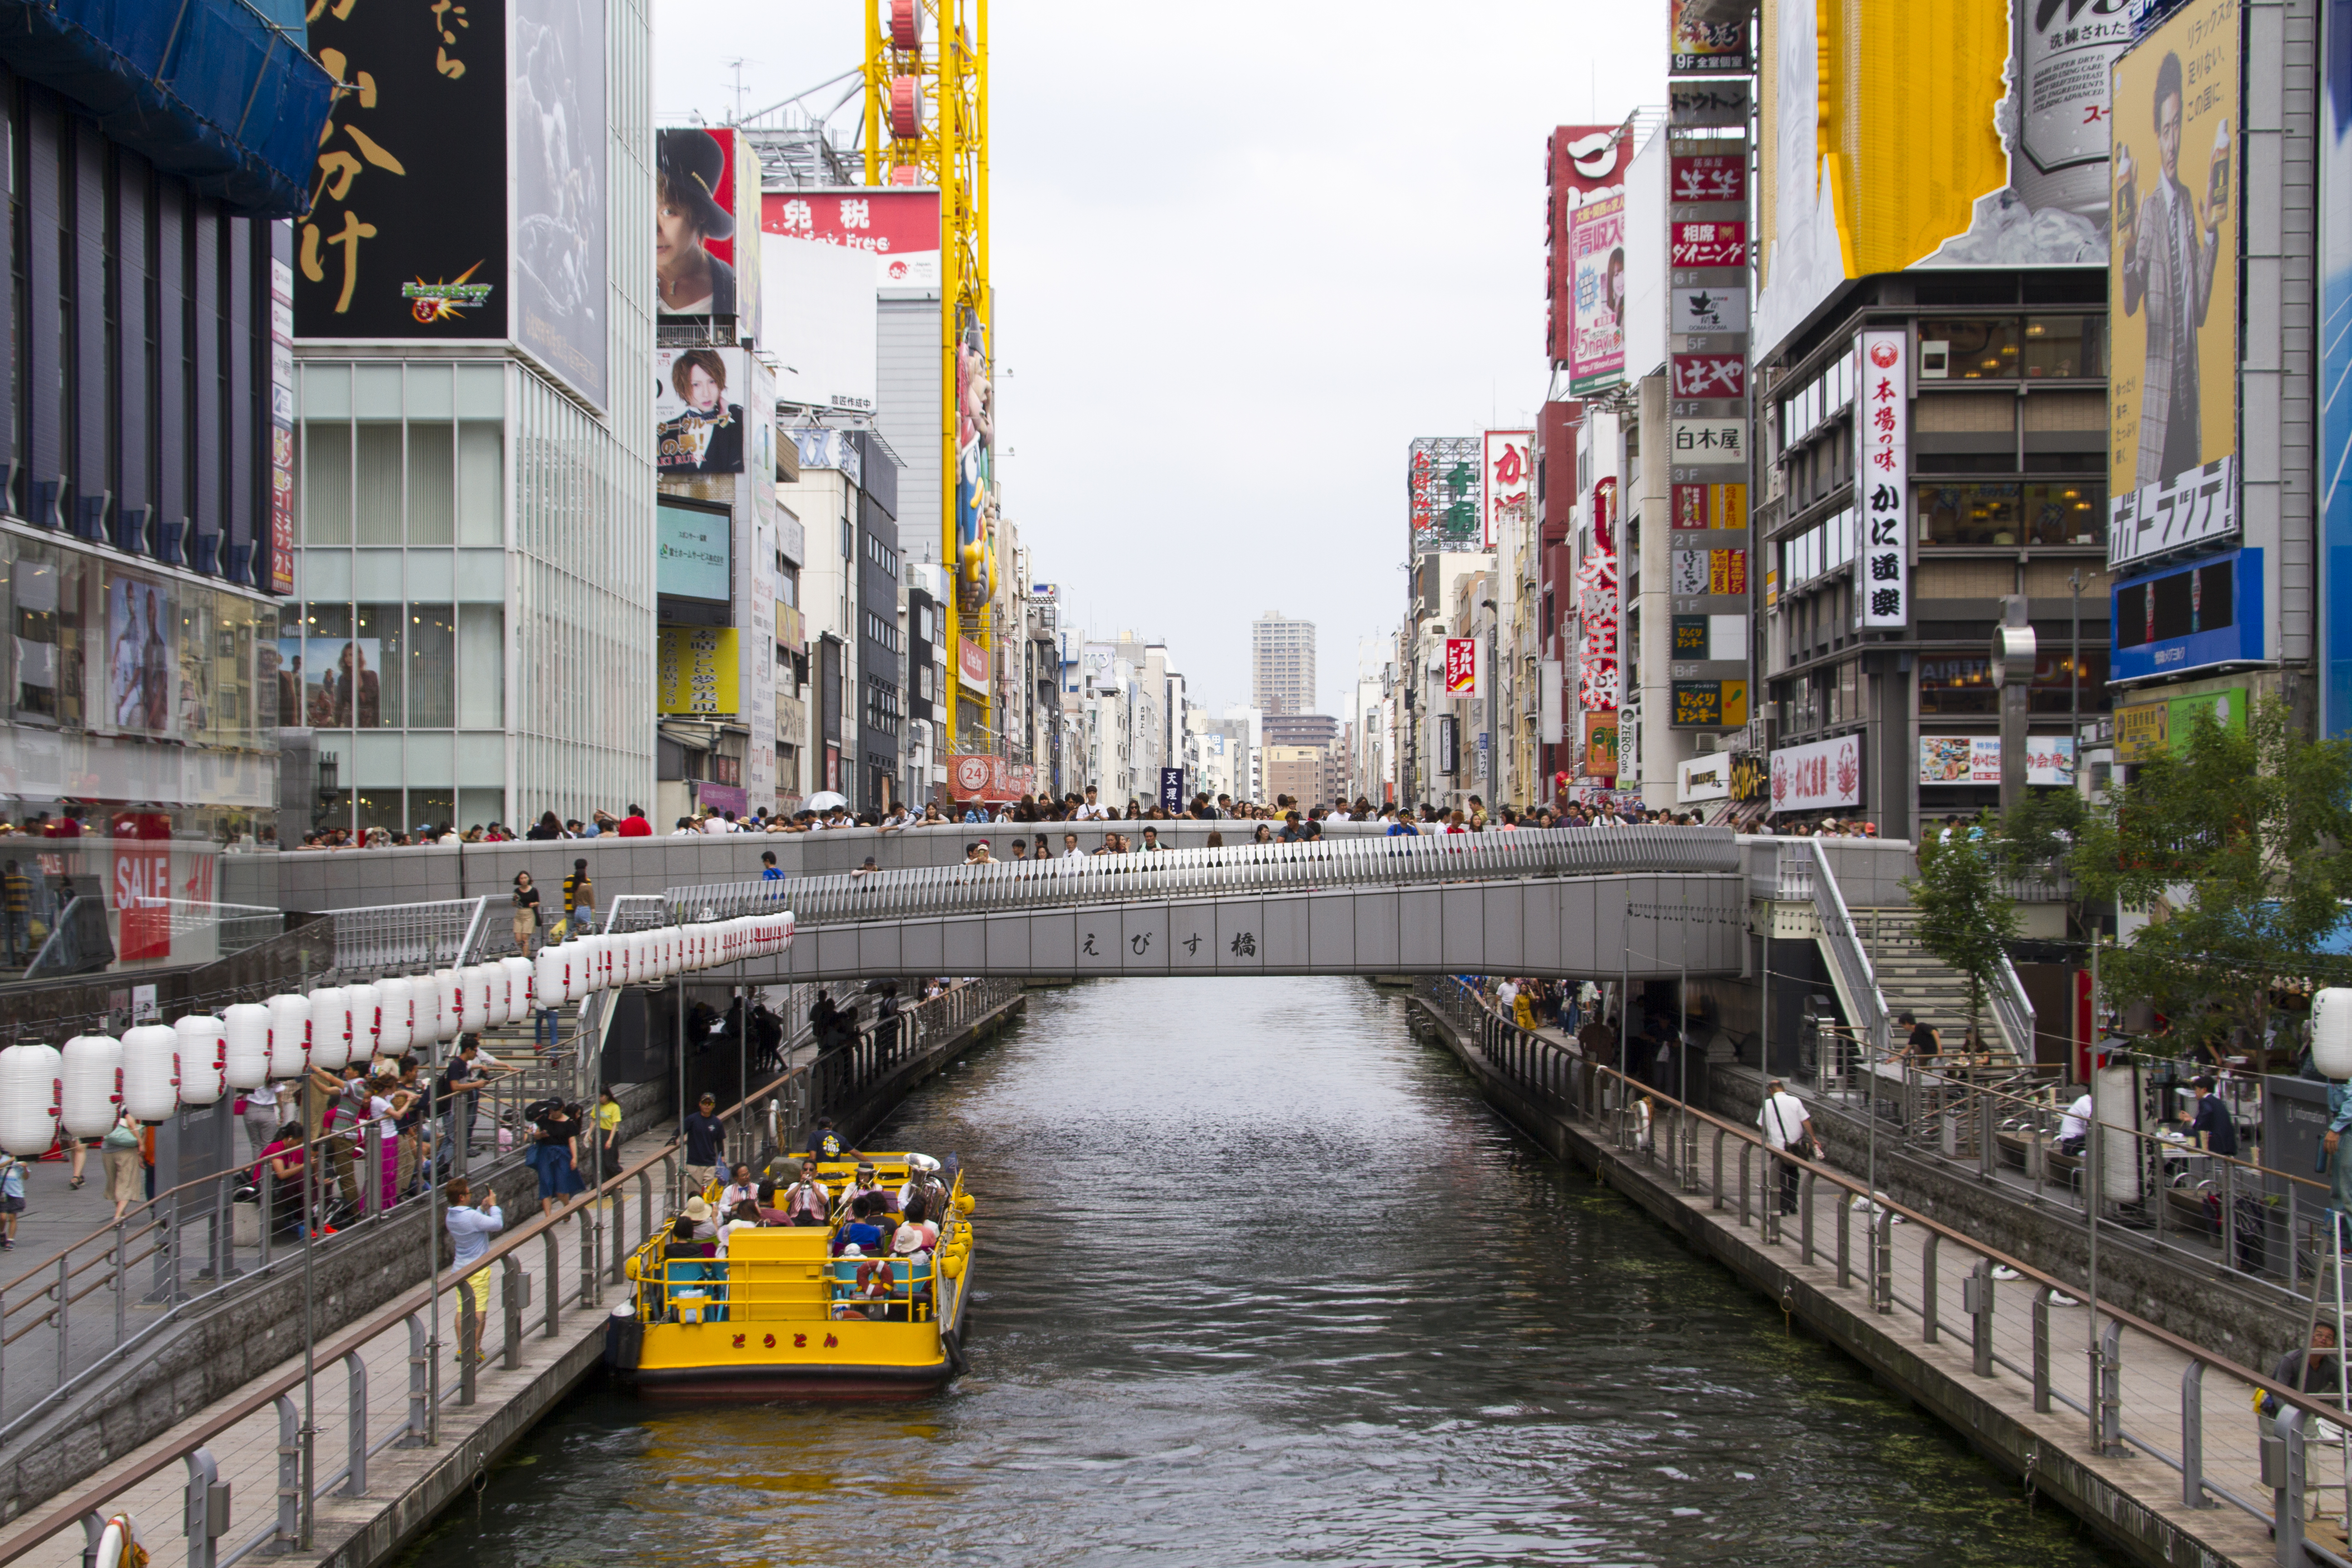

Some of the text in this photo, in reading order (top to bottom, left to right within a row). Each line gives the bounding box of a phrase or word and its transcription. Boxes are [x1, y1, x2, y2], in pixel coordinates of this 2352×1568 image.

[1676, 54, 1743, 69] 9F 全室個室
[2053, 59, 2076, 72] SUPER
[2078, 55, 2095, 64] DRY
[2059, 67, 2080, 78] USING
[2082, 71, 2104, 80] YEAST
[2034, 79, 2105, 105] AND INGREDIENTS
[2064, 88, 2105, 102] ADVANCED
[1675, 168, 1740, 199] 笑笑
[783, 200, 870, 229] 免税
[846, 233, 889, 251] Free
[1683, 225, 1715, 241] 相席
[1674, 243, 1746, 264] ダイニング
[1675, 360, 1744, 395] はや
[831, 394, 871, 408] 意匠作成中
[1872, 377, 1896, 473] 本場の味
[1676, 426, 1740, 450] 白木屋
[1675, 469, 1699, 480] 3F
[1412, 451, 1431, 530] お好み焼
[1674, 534, 1698, 546] 2F
[1676, 600, 1699, 611] 1F
[1679, 627, 1703, 637] びっくり
[1677, 638, 1704, 647] ドンキー
[1448, 647, 1459, 683] ドラッグ
[1460, 642, 1472, 675] ツルハ
[664, 631, 678, 706] あなたのお店づくり
[691, 630, 718, 713] 素晴らしい夢の実現
[1679, 691, 1716, 708] びっくり
[1676, 708, 1719, 723] ドンキー
[1621, 725, 1631, 753] ZERO
[962, 759, 985, 768] OPEN FOR
[966, 767, 982, 780] 24
[117, 856, 167, 910] SALE
[1083, 932, 1256, 957] えびす橋
[2295, 1106, 2328, 1125] information
